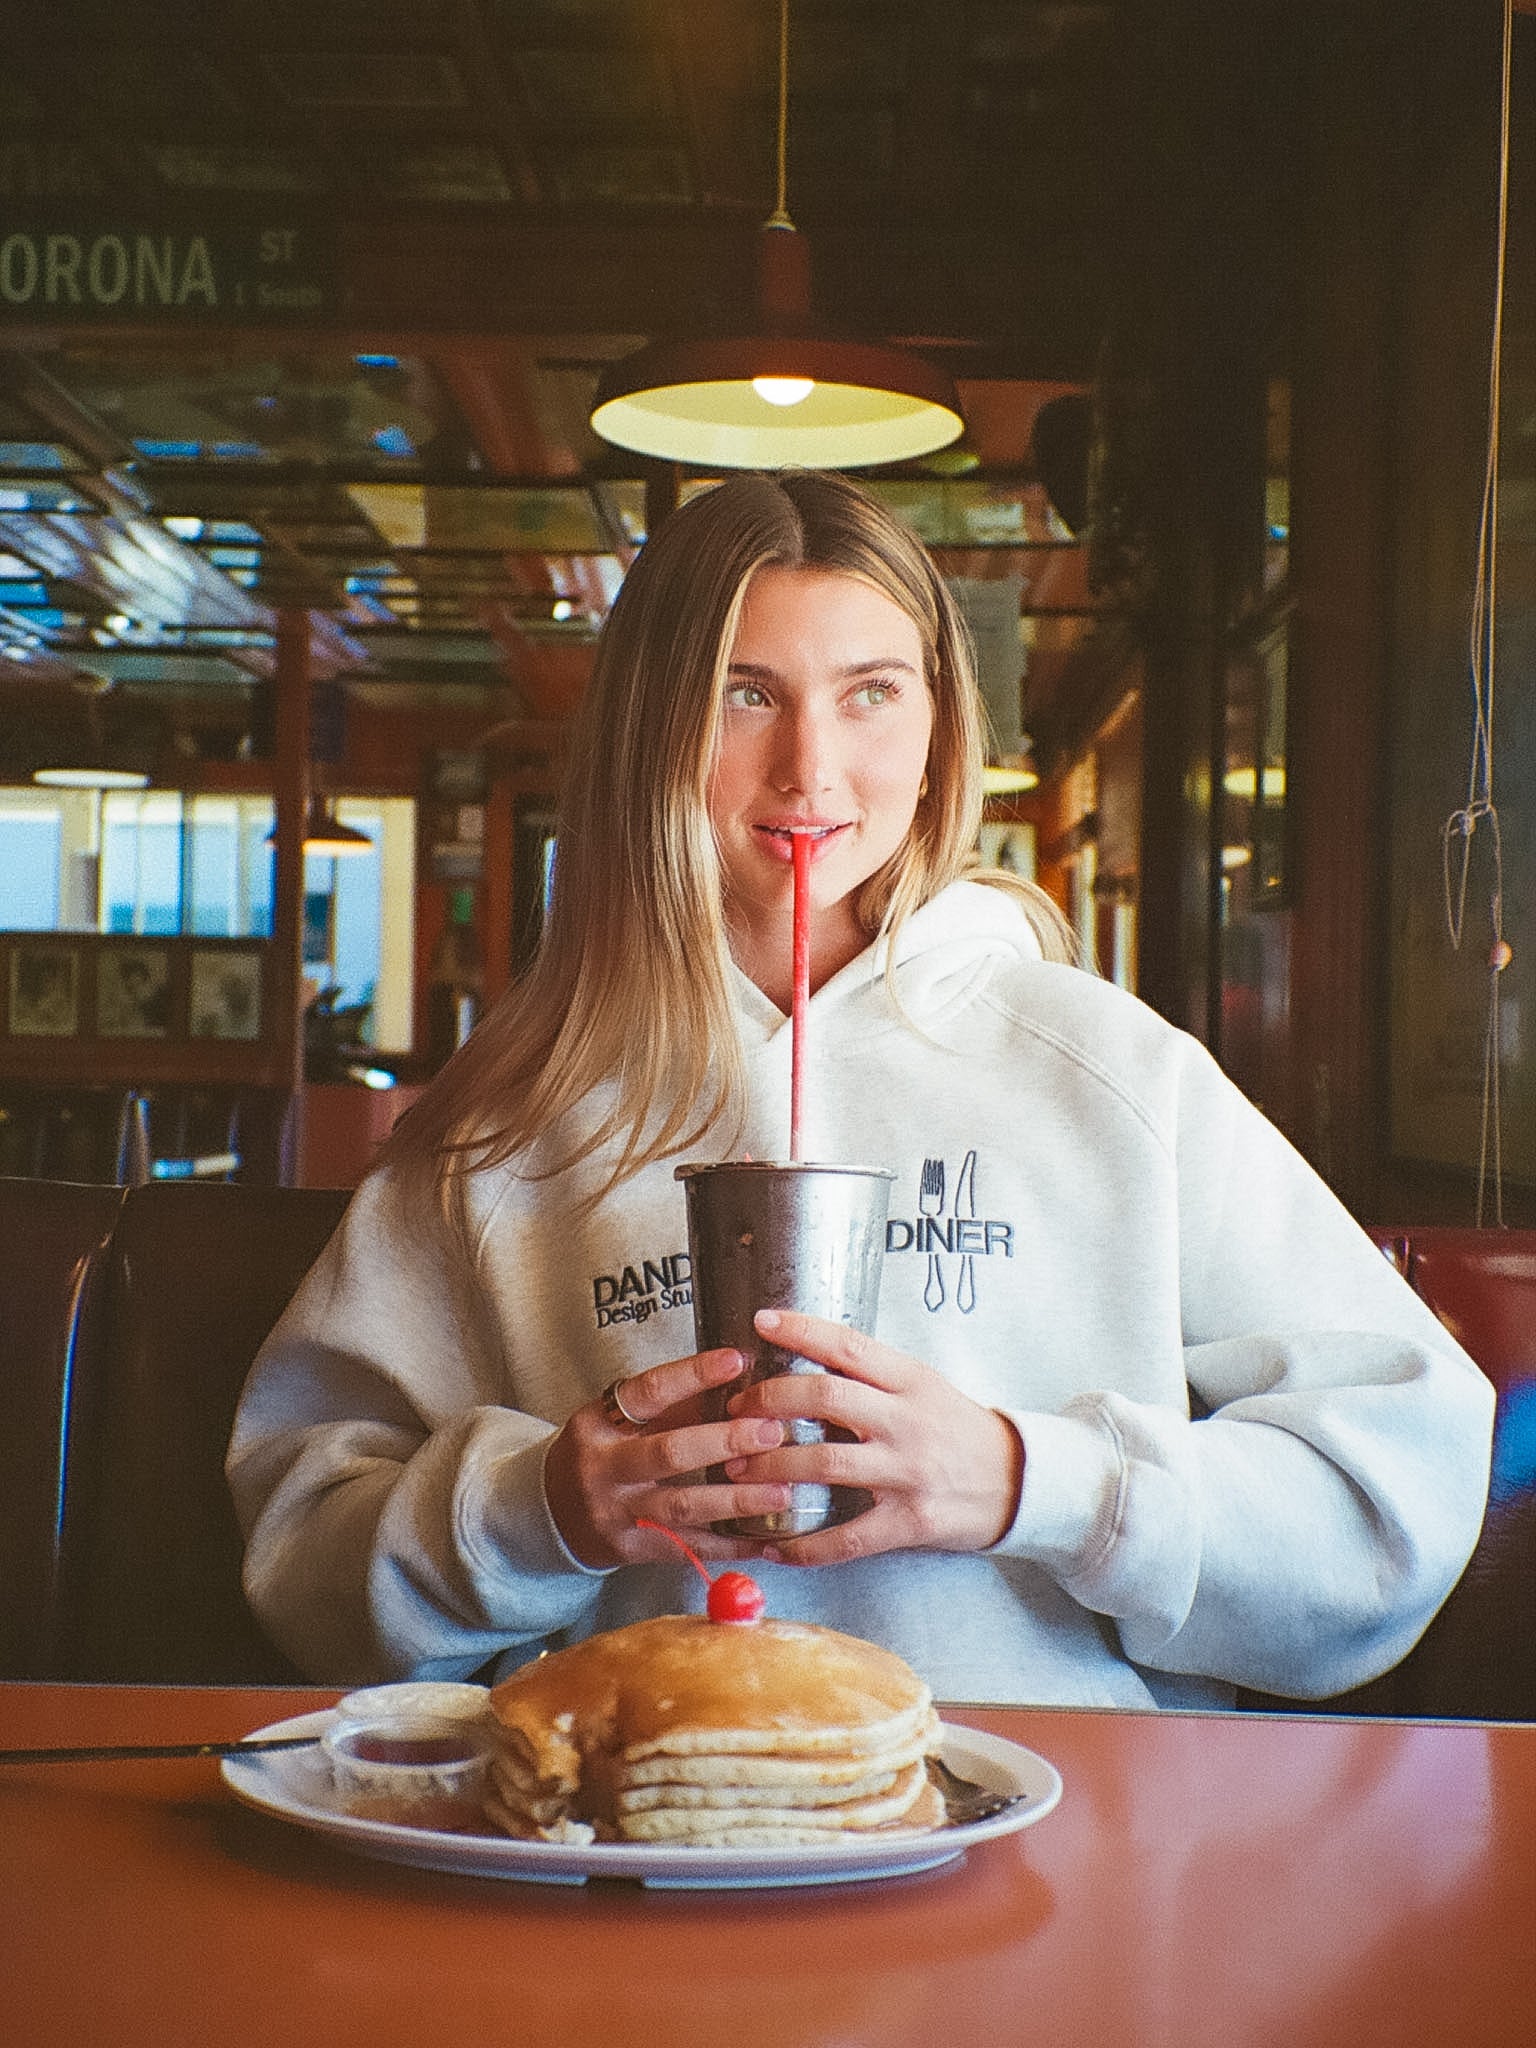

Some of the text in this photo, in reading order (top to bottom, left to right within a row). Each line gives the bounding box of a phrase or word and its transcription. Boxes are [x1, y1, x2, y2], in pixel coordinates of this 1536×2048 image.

[0, 229, 299, 306] ORONA ST
[885, 1218, 1015, 1258] DINER
[597, 1297, 658, 1329] Design
